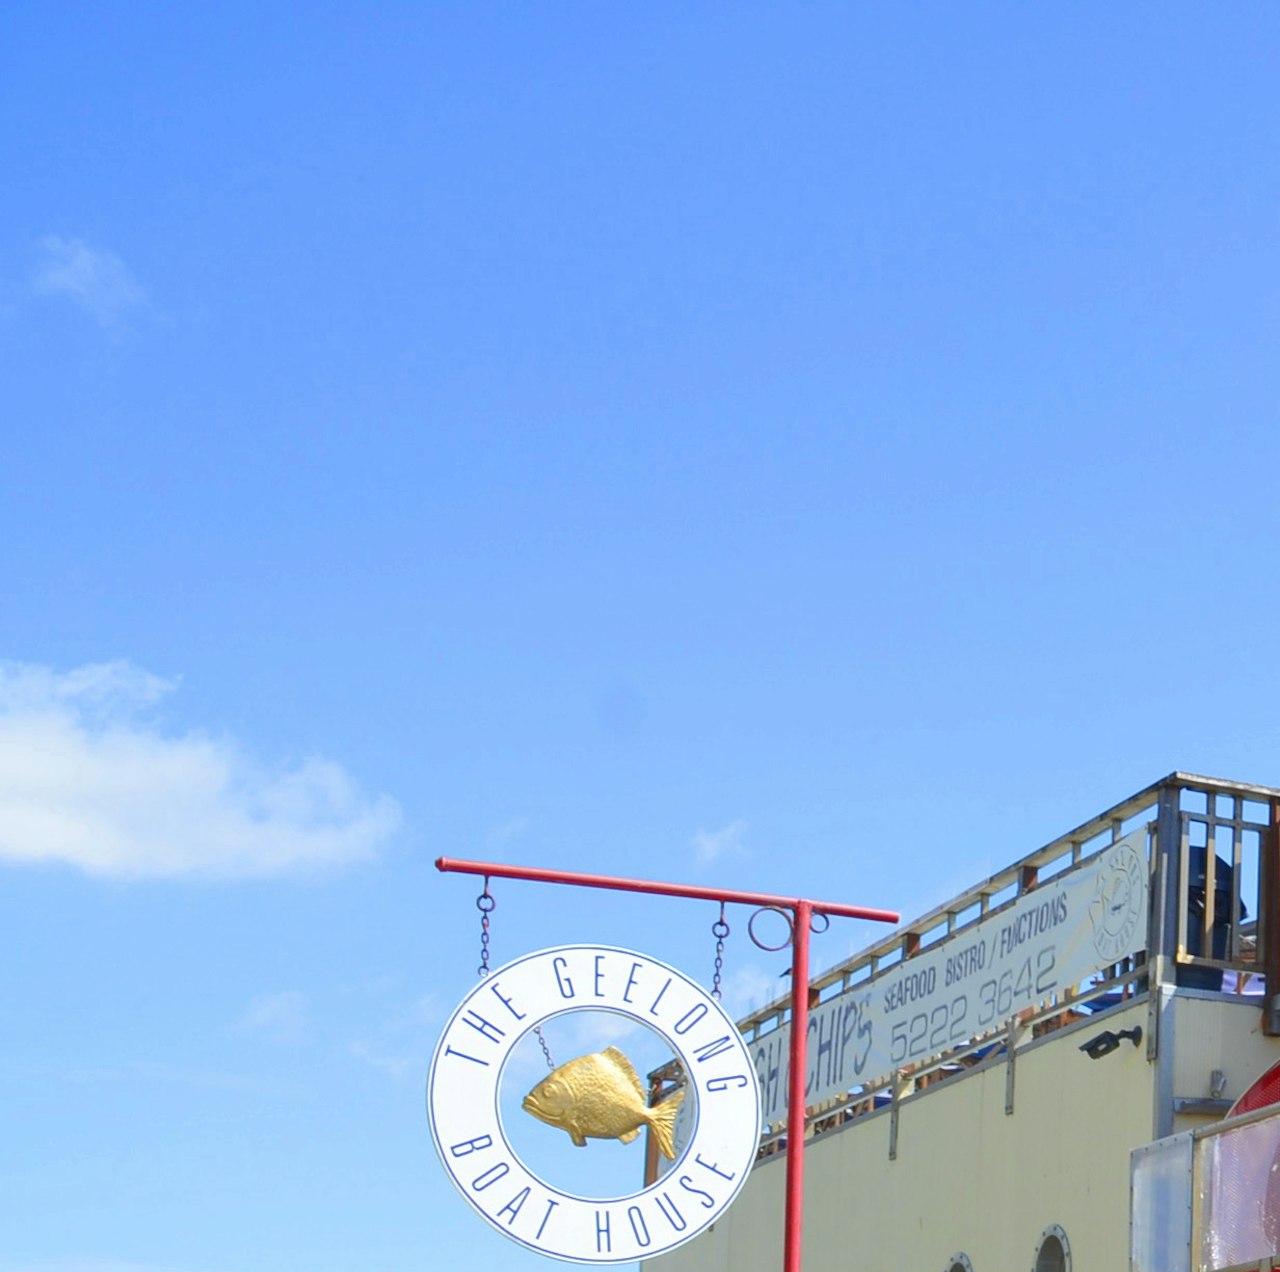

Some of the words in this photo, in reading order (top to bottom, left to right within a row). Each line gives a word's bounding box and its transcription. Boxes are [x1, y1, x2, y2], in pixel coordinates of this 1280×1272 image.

[883, 966, 937, 1014] SEAFOOD
[945, 939, 986, 987] BISTRO
[1000, 891, 1068, 959] FUNCTIONS
[890, 995, 968, 1063] 5222
[978, 945, 1058, 1026] 3642
[444, 983, 527, 1067] THE
[552, 955, 748, 1093] GEELONG
[805, 992, 872, 1100] CHIPS
[450, 1134, 560, 1240] BOAT
[595, 1153, 736, 1253] HOUSE
